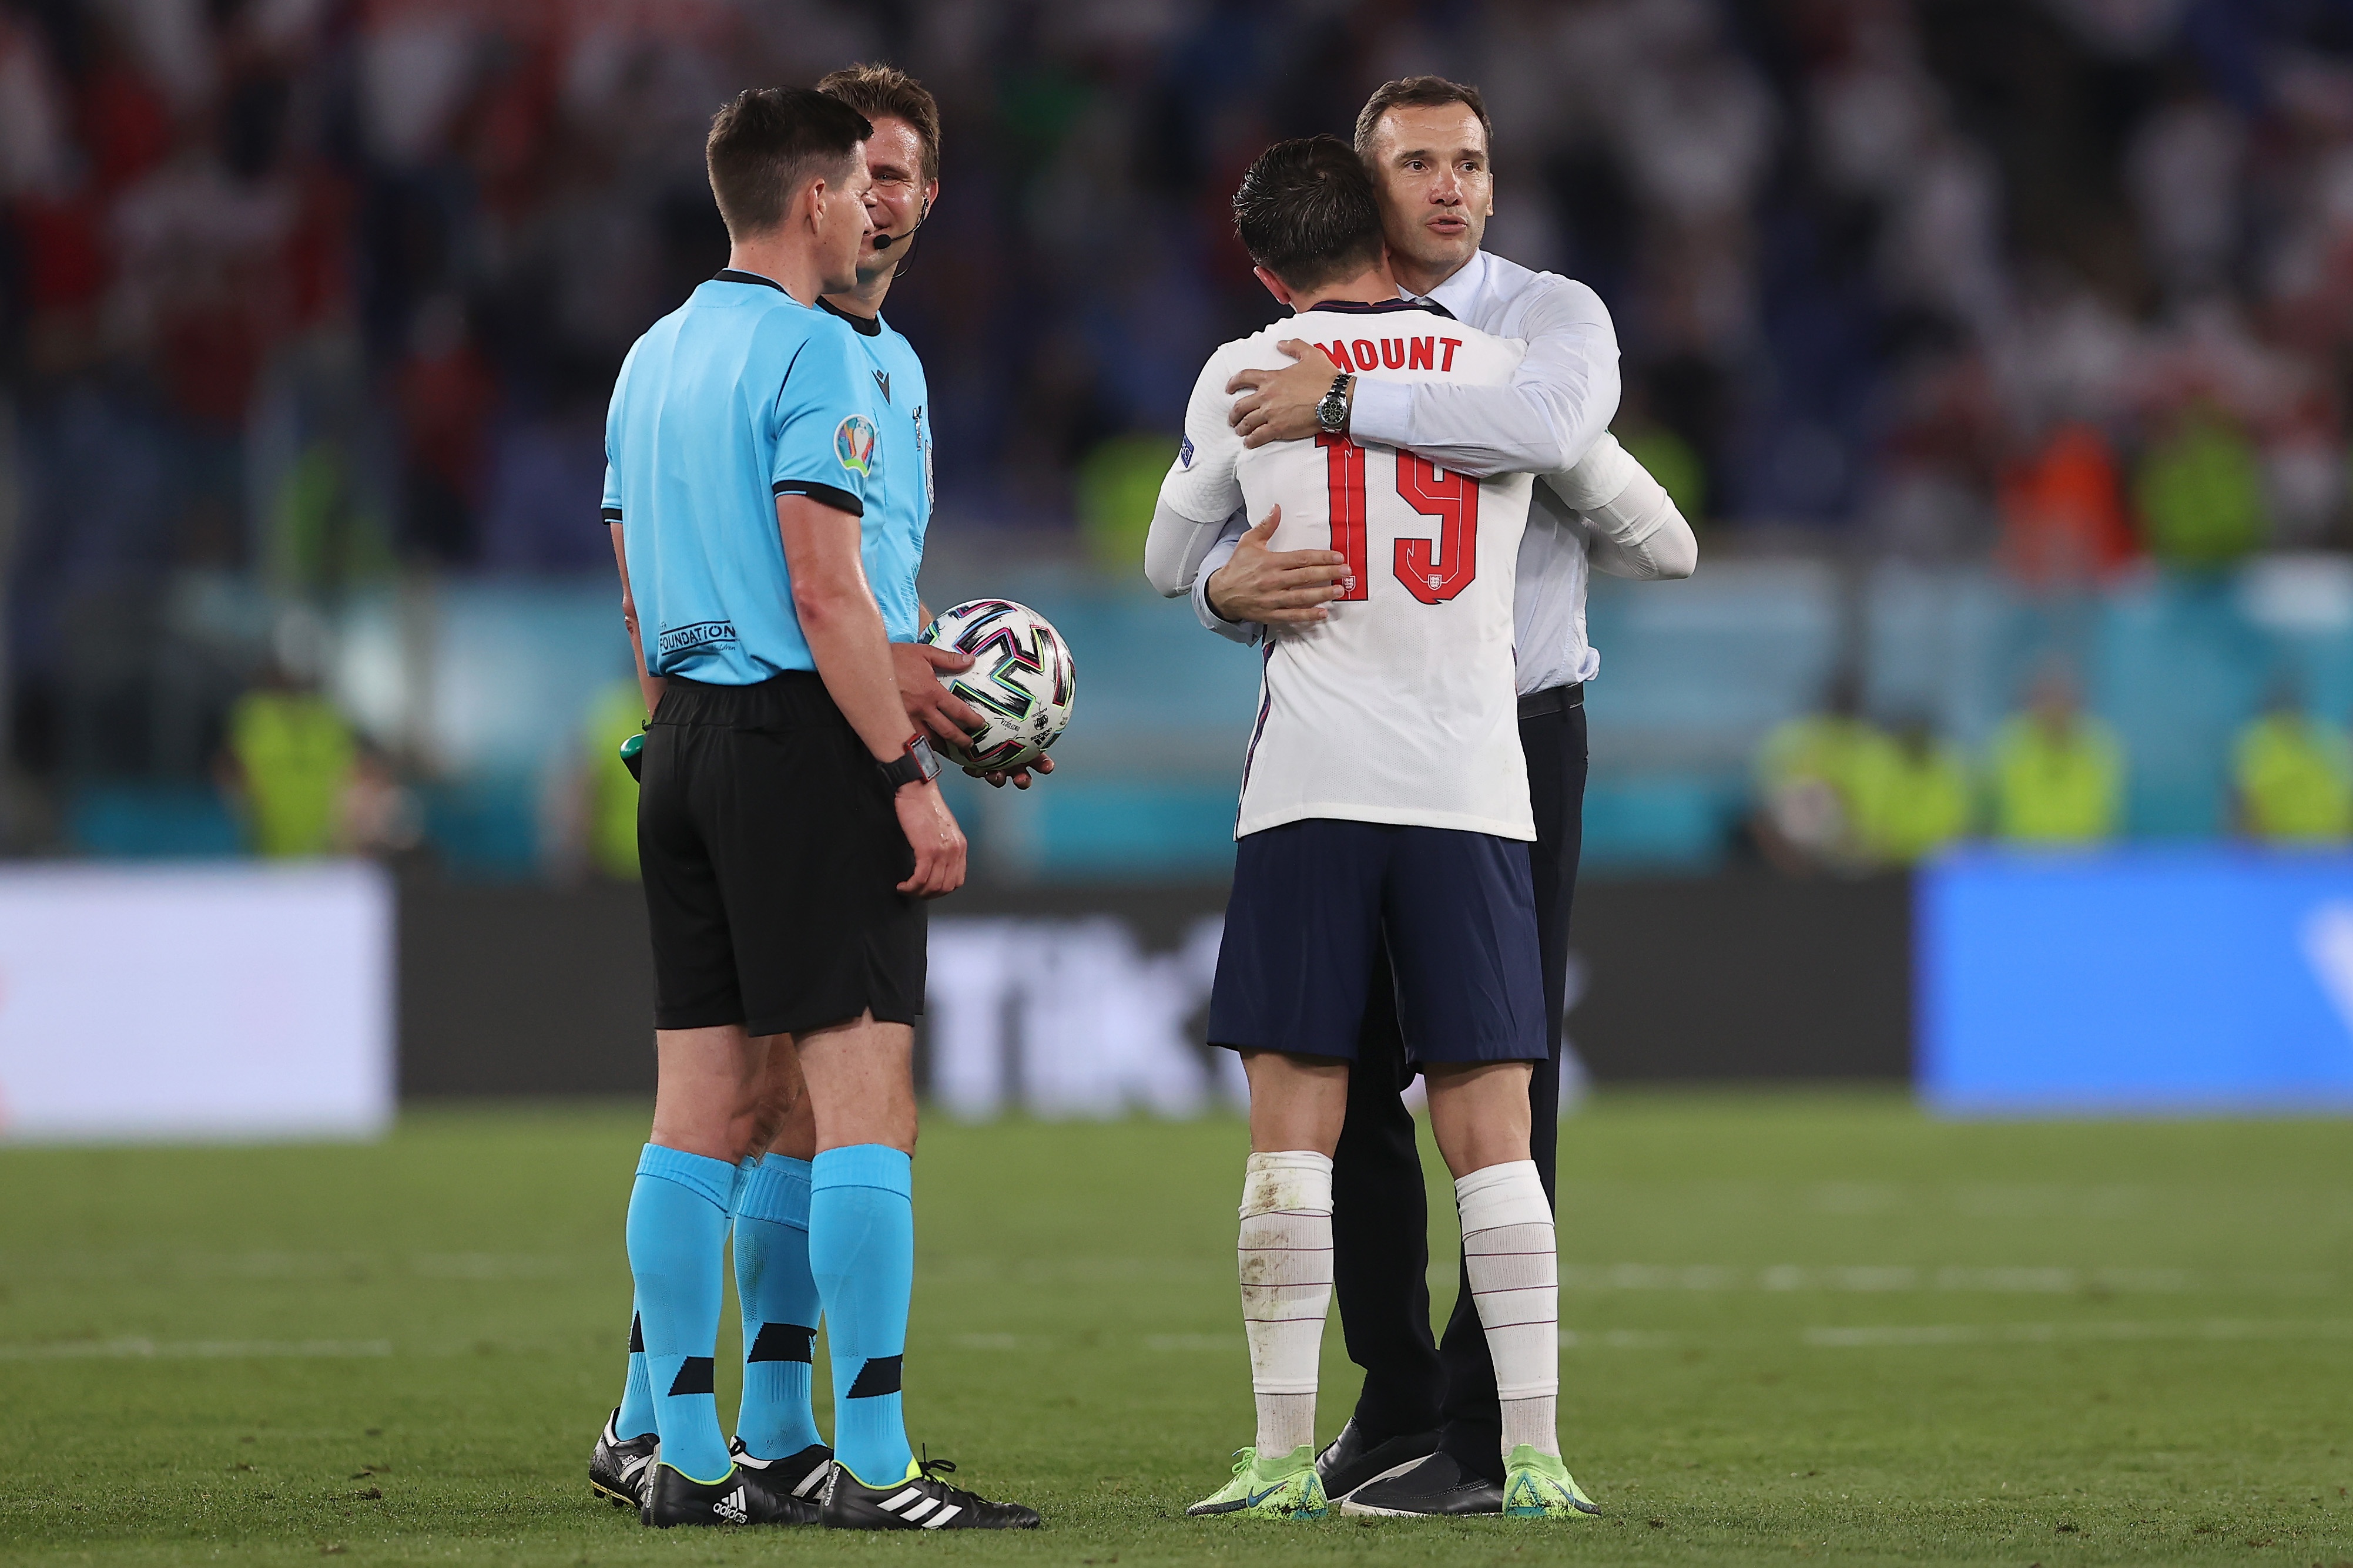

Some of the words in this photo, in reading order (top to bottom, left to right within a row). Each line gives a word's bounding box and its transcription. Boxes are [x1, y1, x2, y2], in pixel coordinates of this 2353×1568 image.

[1314, 335, 1462, 374] MOUNT
[1315, 432, 1480, 605] 19
[1030, 727, 1053, 741] adidas
[713, 1501, 748, 1524] adidas
